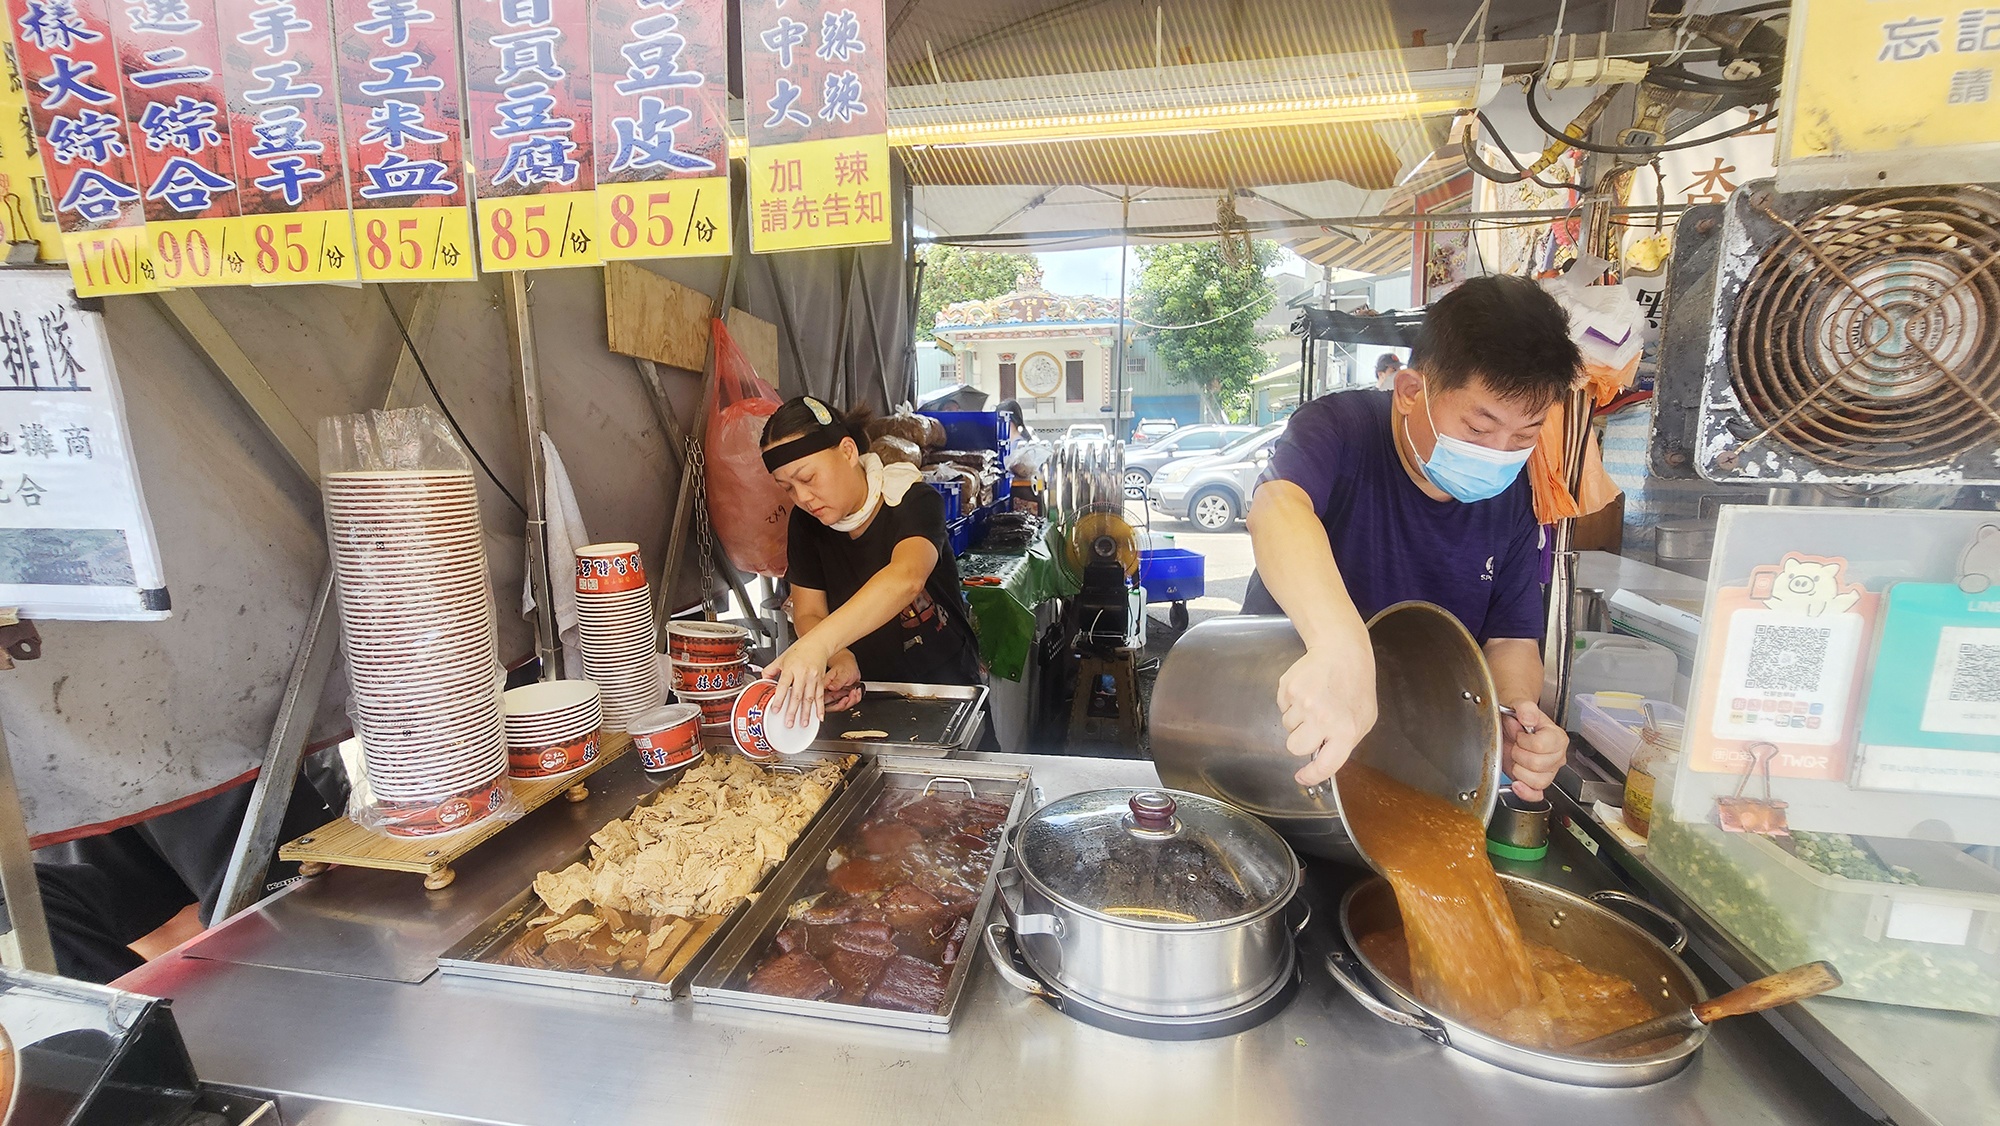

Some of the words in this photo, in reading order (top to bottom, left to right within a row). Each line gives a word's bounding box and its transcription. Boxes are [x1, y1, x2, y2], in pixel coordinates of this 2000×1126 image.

[607, 0, 717, 173] 豆皮
[760, 190, 884, 233] 請先告知
[1781, 753, 1829, 769] TWQR
